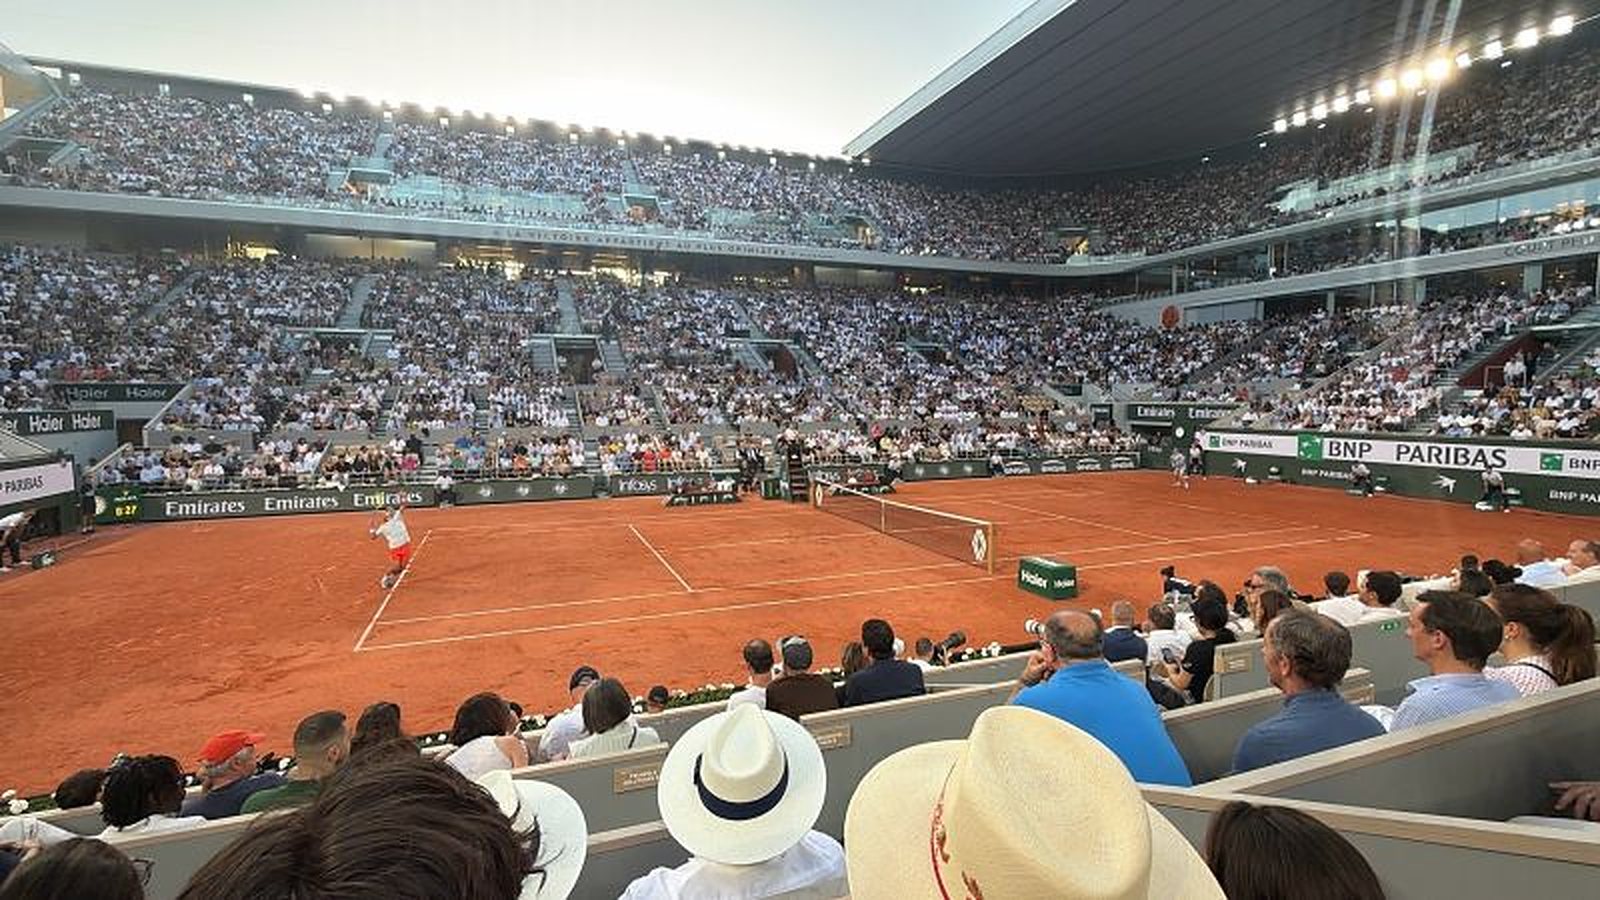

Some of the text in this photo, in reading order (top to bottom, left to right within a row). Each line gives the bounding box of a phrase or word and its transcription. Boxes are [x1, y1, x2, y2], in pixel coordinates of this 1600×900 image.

[66, 387, 167, 399] Haier Haier
[30, 414, 63, 432] Haier
[72, 412, 101, 430] Haier
[1329, 441, 1507, 469] BNP PARIBAS
[1569, 457, 1600, 470] BNP
[5, 475, 44, 494] PARIBAS
[1549, 490, 1577, 500] BNP
[165, 499, 245, 516] Emirates
[264, 495, 339, 511] Emirates
[1021, 569, 1047, 589] Haier
